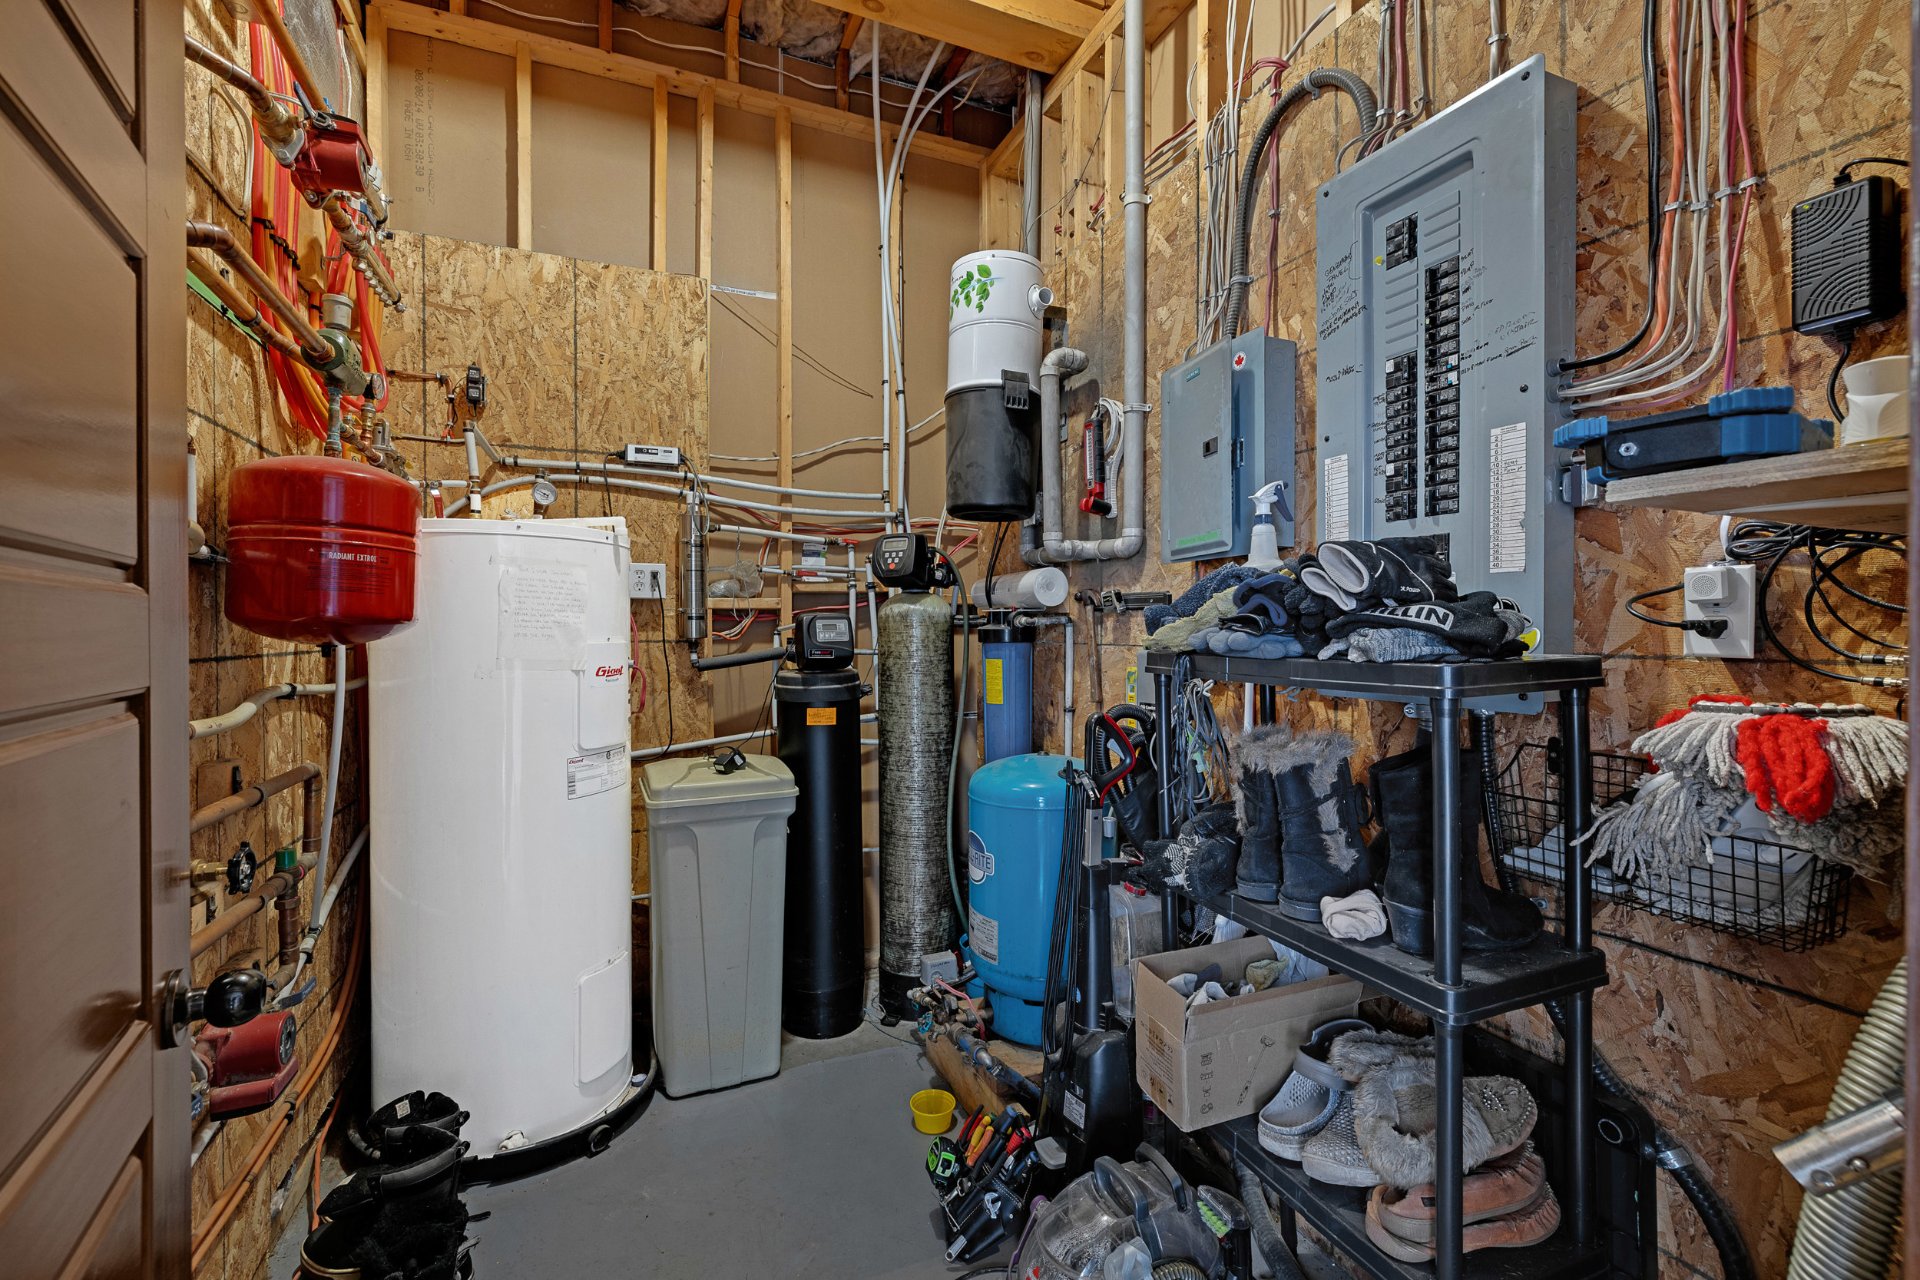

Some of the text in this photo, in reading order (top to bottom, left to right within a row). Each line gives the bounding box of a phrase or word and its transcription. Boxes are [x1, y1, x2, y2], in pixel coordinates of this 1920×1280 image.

[414, 68, 426, 114] 08/08/14
[403, 98, 414, 162] MADE IN USA
[328, 551, 377, 563] RADIANT EXTROL
[595, 665, 624, 678] Giant
